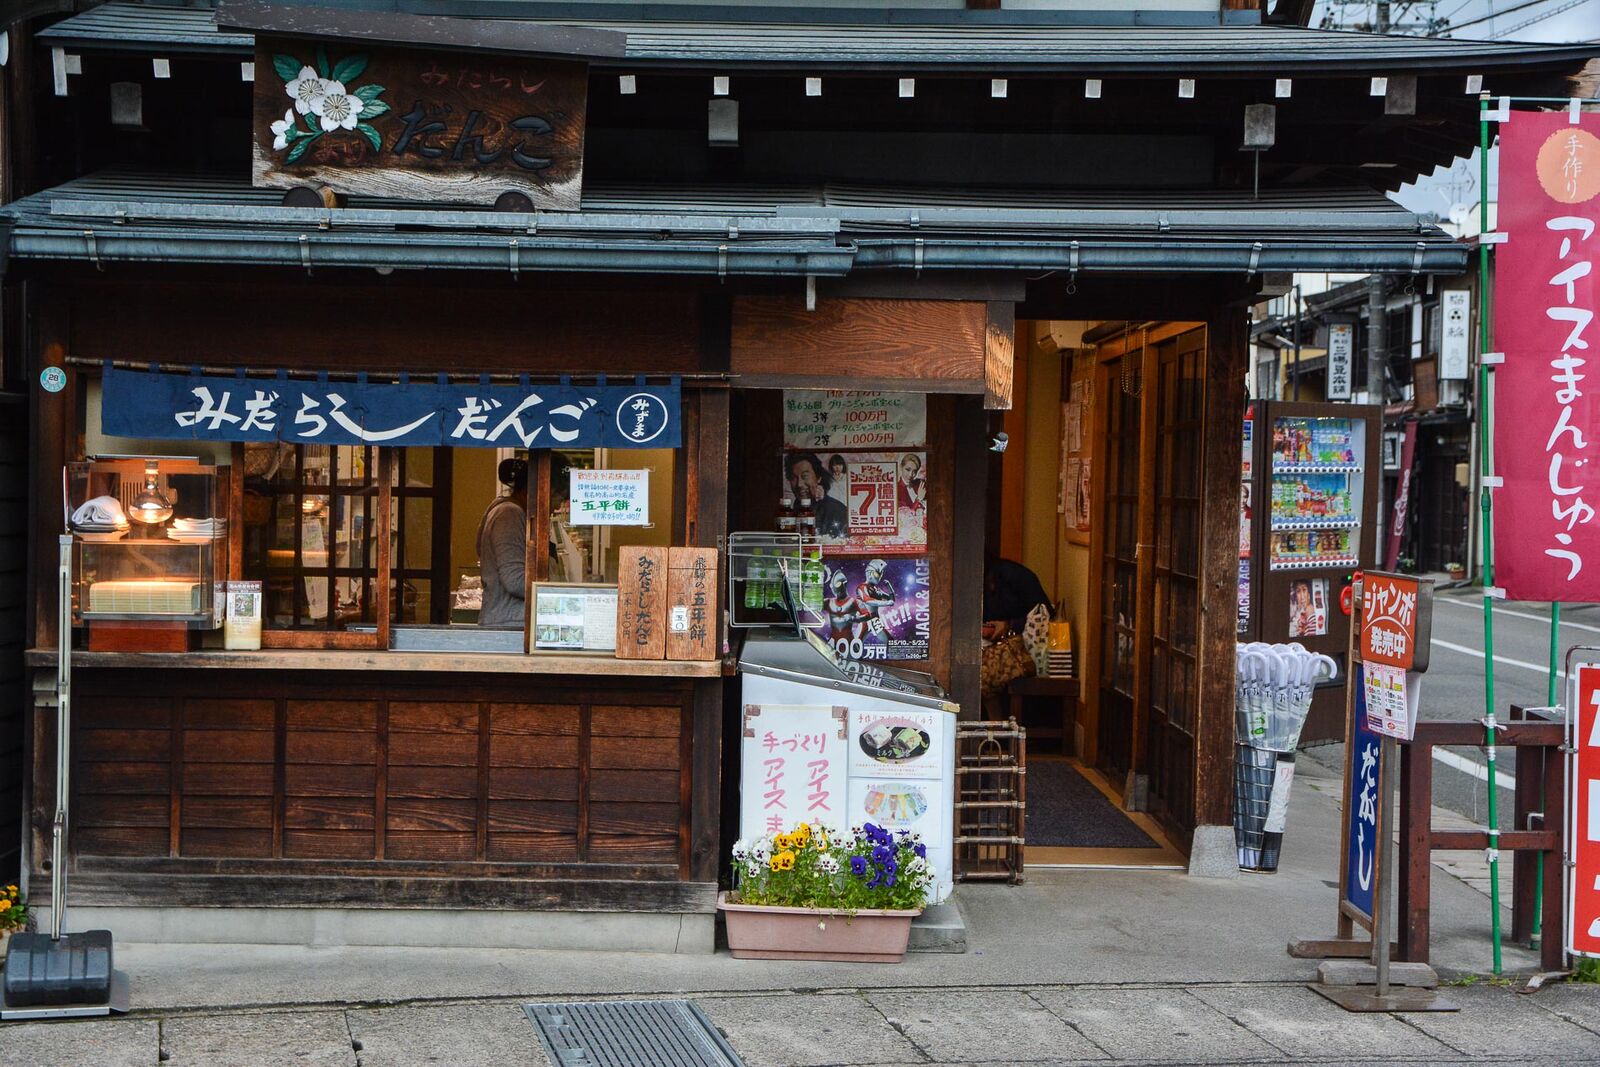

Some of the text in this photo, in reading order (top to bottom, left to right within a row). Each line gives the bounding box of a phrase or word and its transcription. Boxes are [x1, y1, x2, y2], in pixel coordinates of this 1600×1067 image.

[1562, 135, 1583, 201] 手作り
[845, 410, 888, 423] 100万円
[1544, 216, 1595, 581] アイスまんじゅう
[915, 559, 930, 591] ACE
[915, 606, 930, 640] JACK
[1363, 582, 1416, 627] ジャンボ
[1370, 626, 1407, 660] 発売中
[762, 731, 827, 754] 手づくり
[807, 759, 831, 824] アイス
[1357, 743, 1379, 891] だがし
